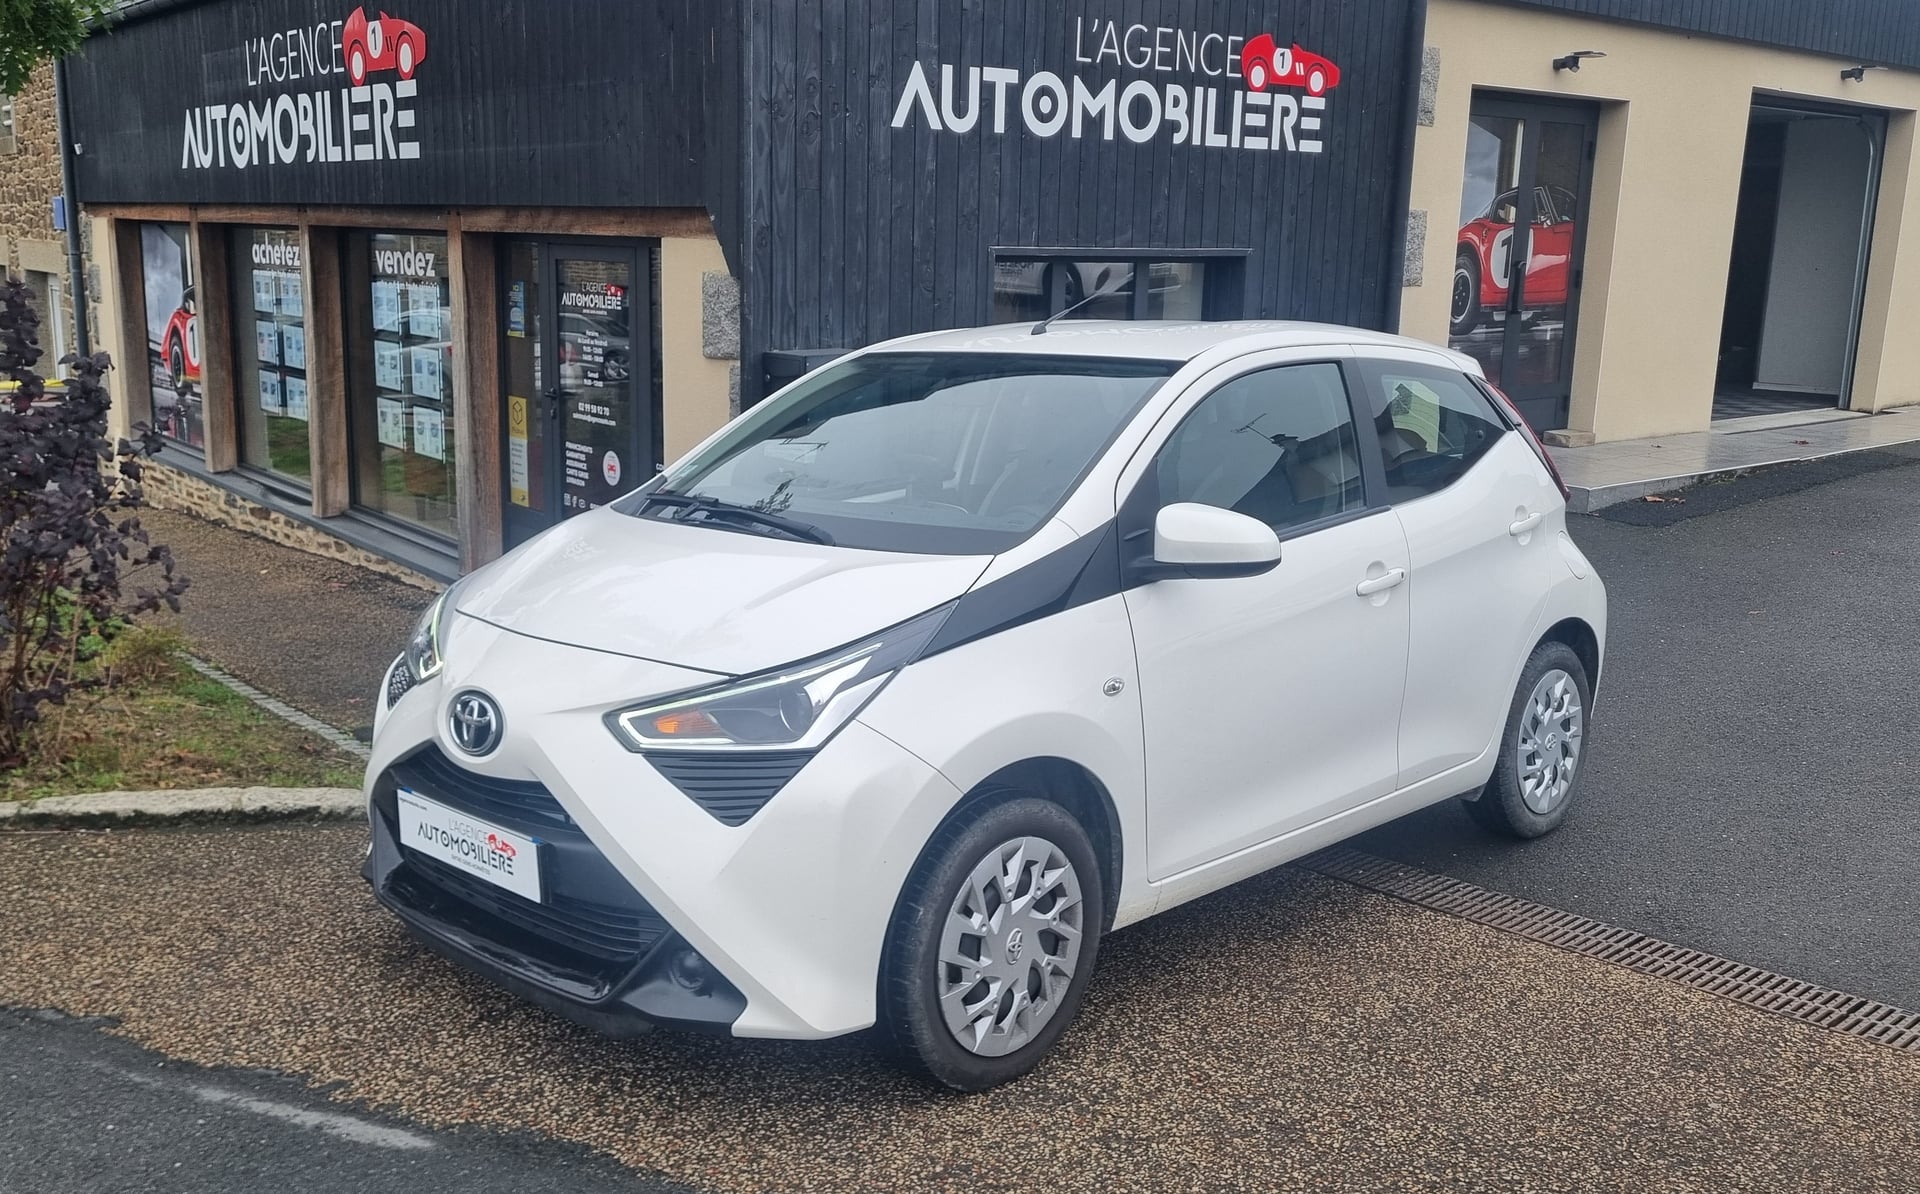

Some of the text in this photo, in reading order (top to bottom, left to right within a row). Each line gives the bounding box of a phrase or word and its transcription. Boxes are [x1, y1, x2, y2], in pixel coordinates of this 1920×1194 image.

[244, 20, 345, 86] L'AGENCE
[1074, 15, 1244, 78] L'AGENCE
[181, 78, 421, 169] AUTOMOBILIERE
[890, 59, 1327, 153] AUTOMOBILIERE
[251, 231, 301, 267] achetez
[374, 235, 437, 277] vendez
[581, 281, 607, 294] L'AGENCE
[417, 821, 514, 876] AUTOMOBILIERE
[448, 818, 488, 845] L'AGENCE
